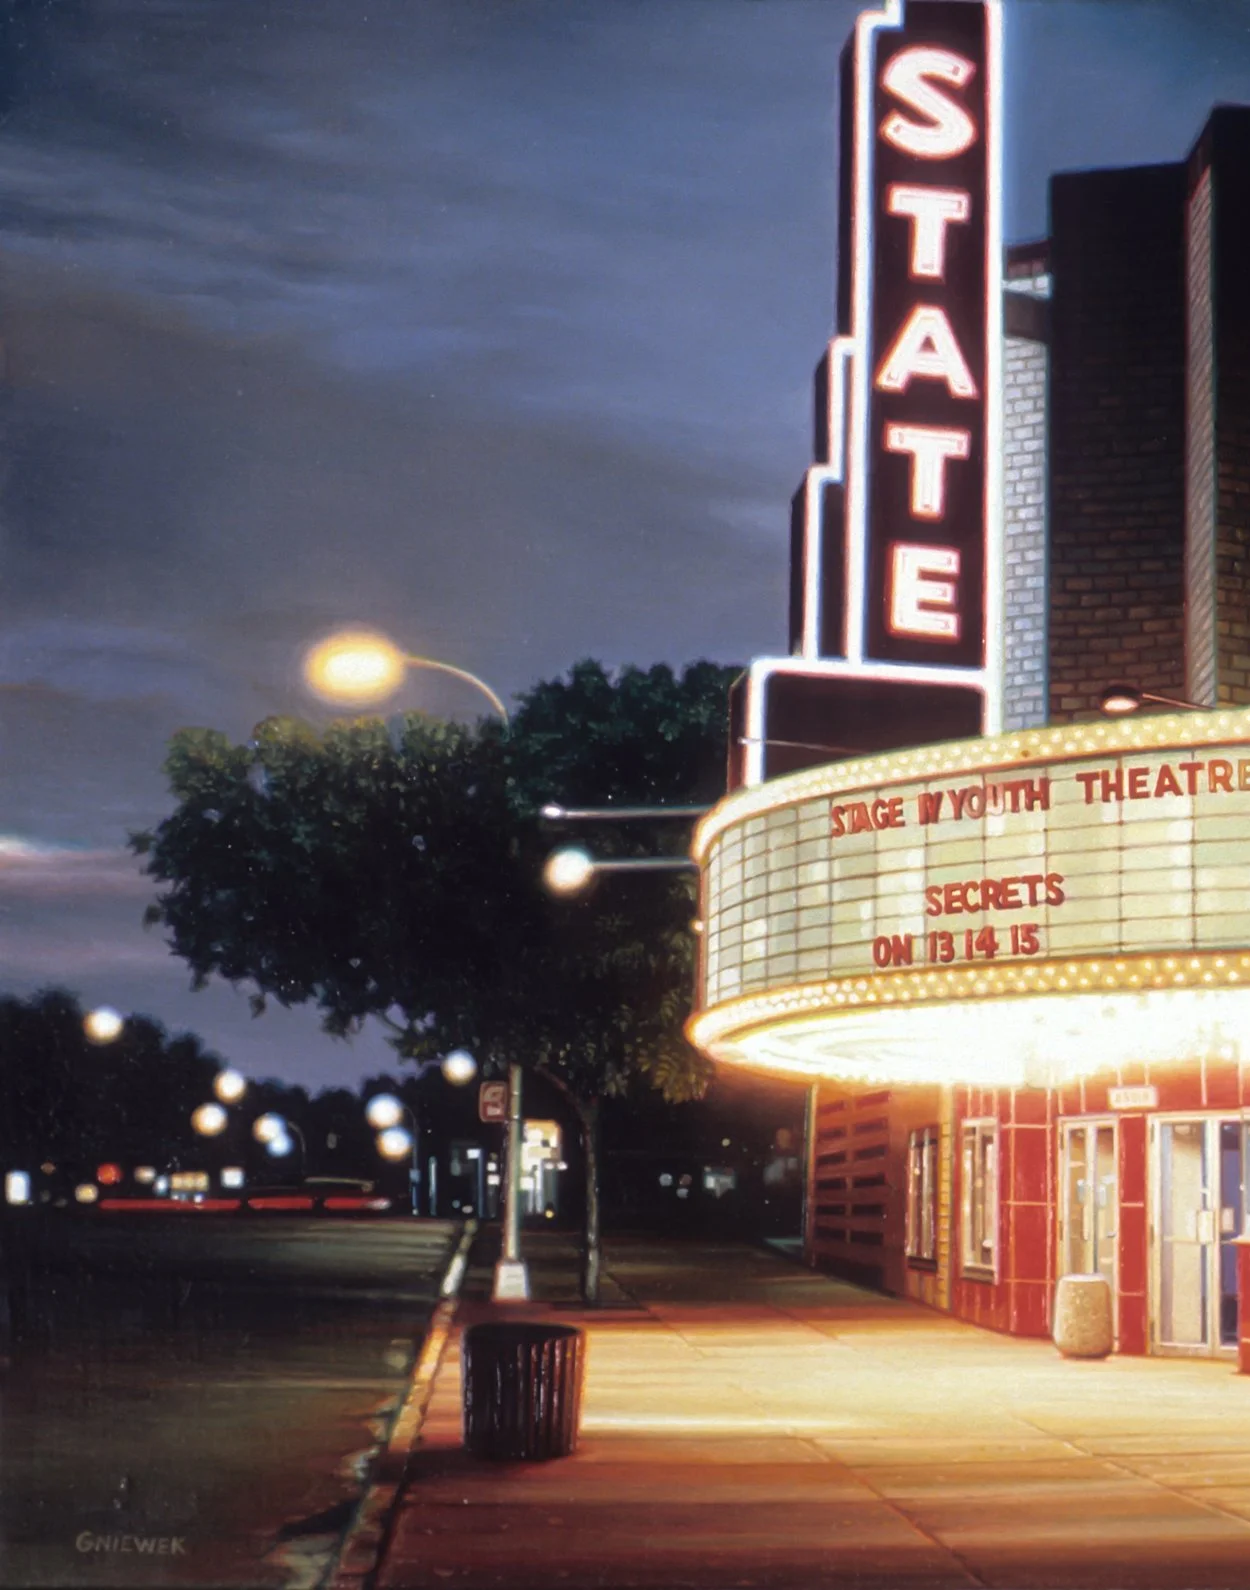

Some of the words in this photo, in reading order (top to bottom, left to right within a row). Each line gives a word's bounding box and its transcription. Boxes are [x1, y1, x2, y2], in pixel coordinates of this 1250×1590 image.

[878, 46, 977, 640] STATE
[831, 797, 906, 838] STAGE
[948, 777, 1050, 820] YOUTH
[925, 872, 1065, 917] SECRETS
[873, 933, 914, 968] ON
[928, 930, 955, 963] 13
[964, 925, 1000, 960] 14
[1011, 923, 1040, 955] 15
[75, 1531, 187, 1555] GNIEWEK
